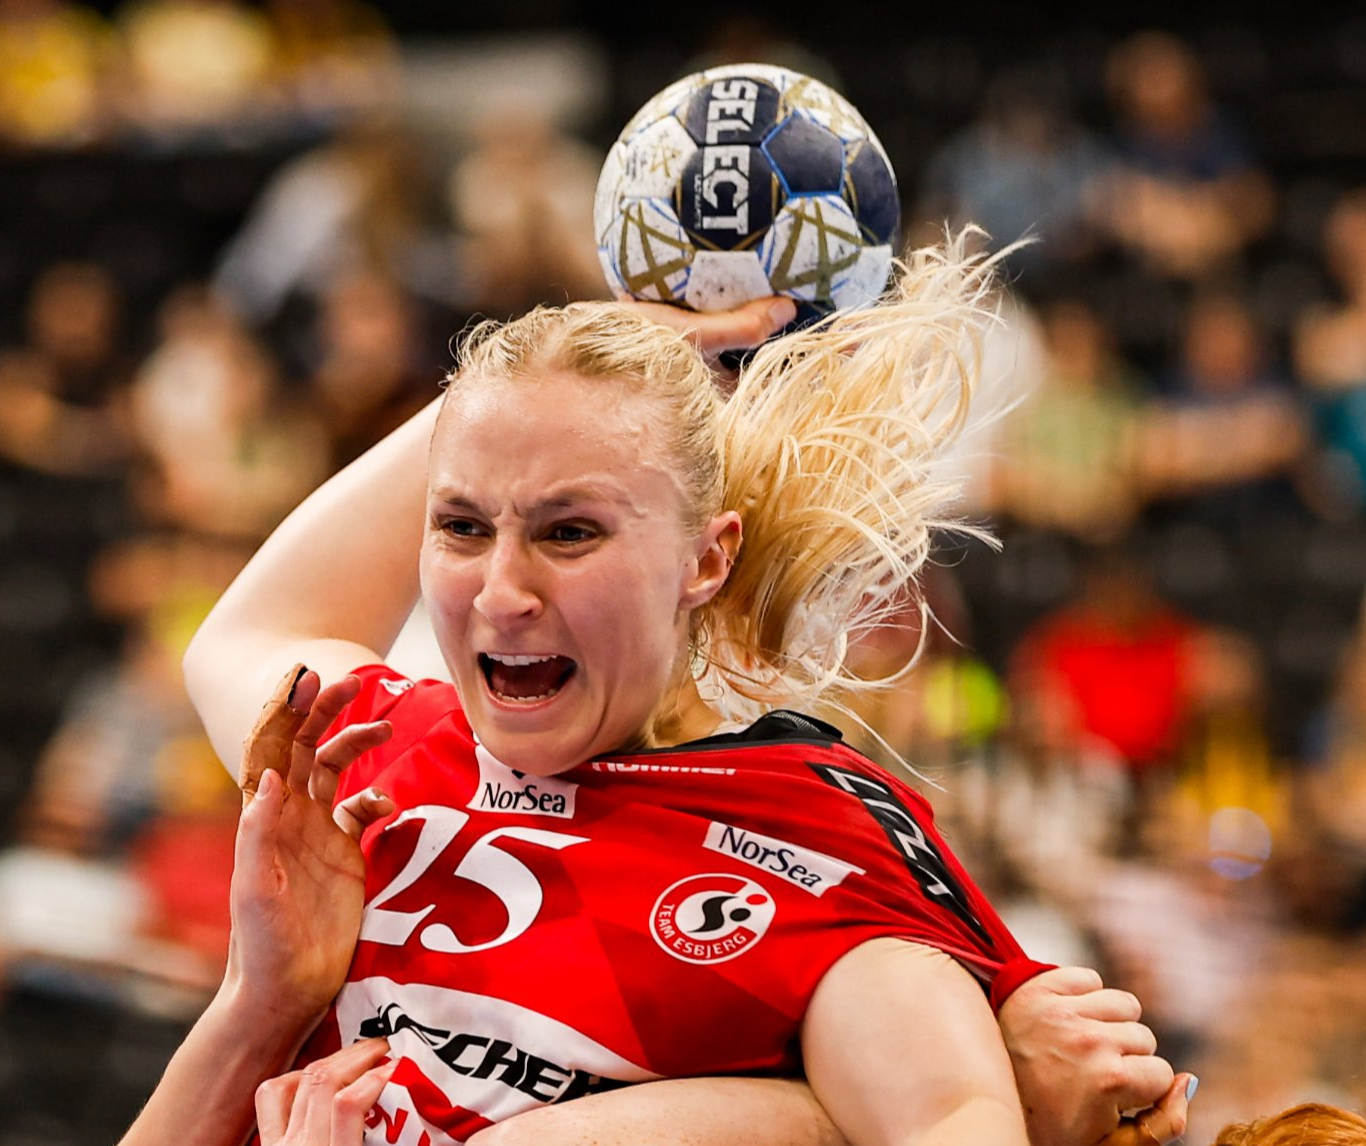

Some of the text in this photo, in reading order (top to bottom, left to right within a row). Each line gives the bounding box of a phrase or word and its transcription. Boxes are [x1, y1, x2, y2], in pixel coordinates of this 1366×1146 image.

[701, 79, 758, 235] SELECT
[480, 783, 567, 815] NorSea
[359, 804, 592, 954] 25
[718, 826, 823, 889] NorSea
[658, 903, 748, 959] TEAM ESBJERG
